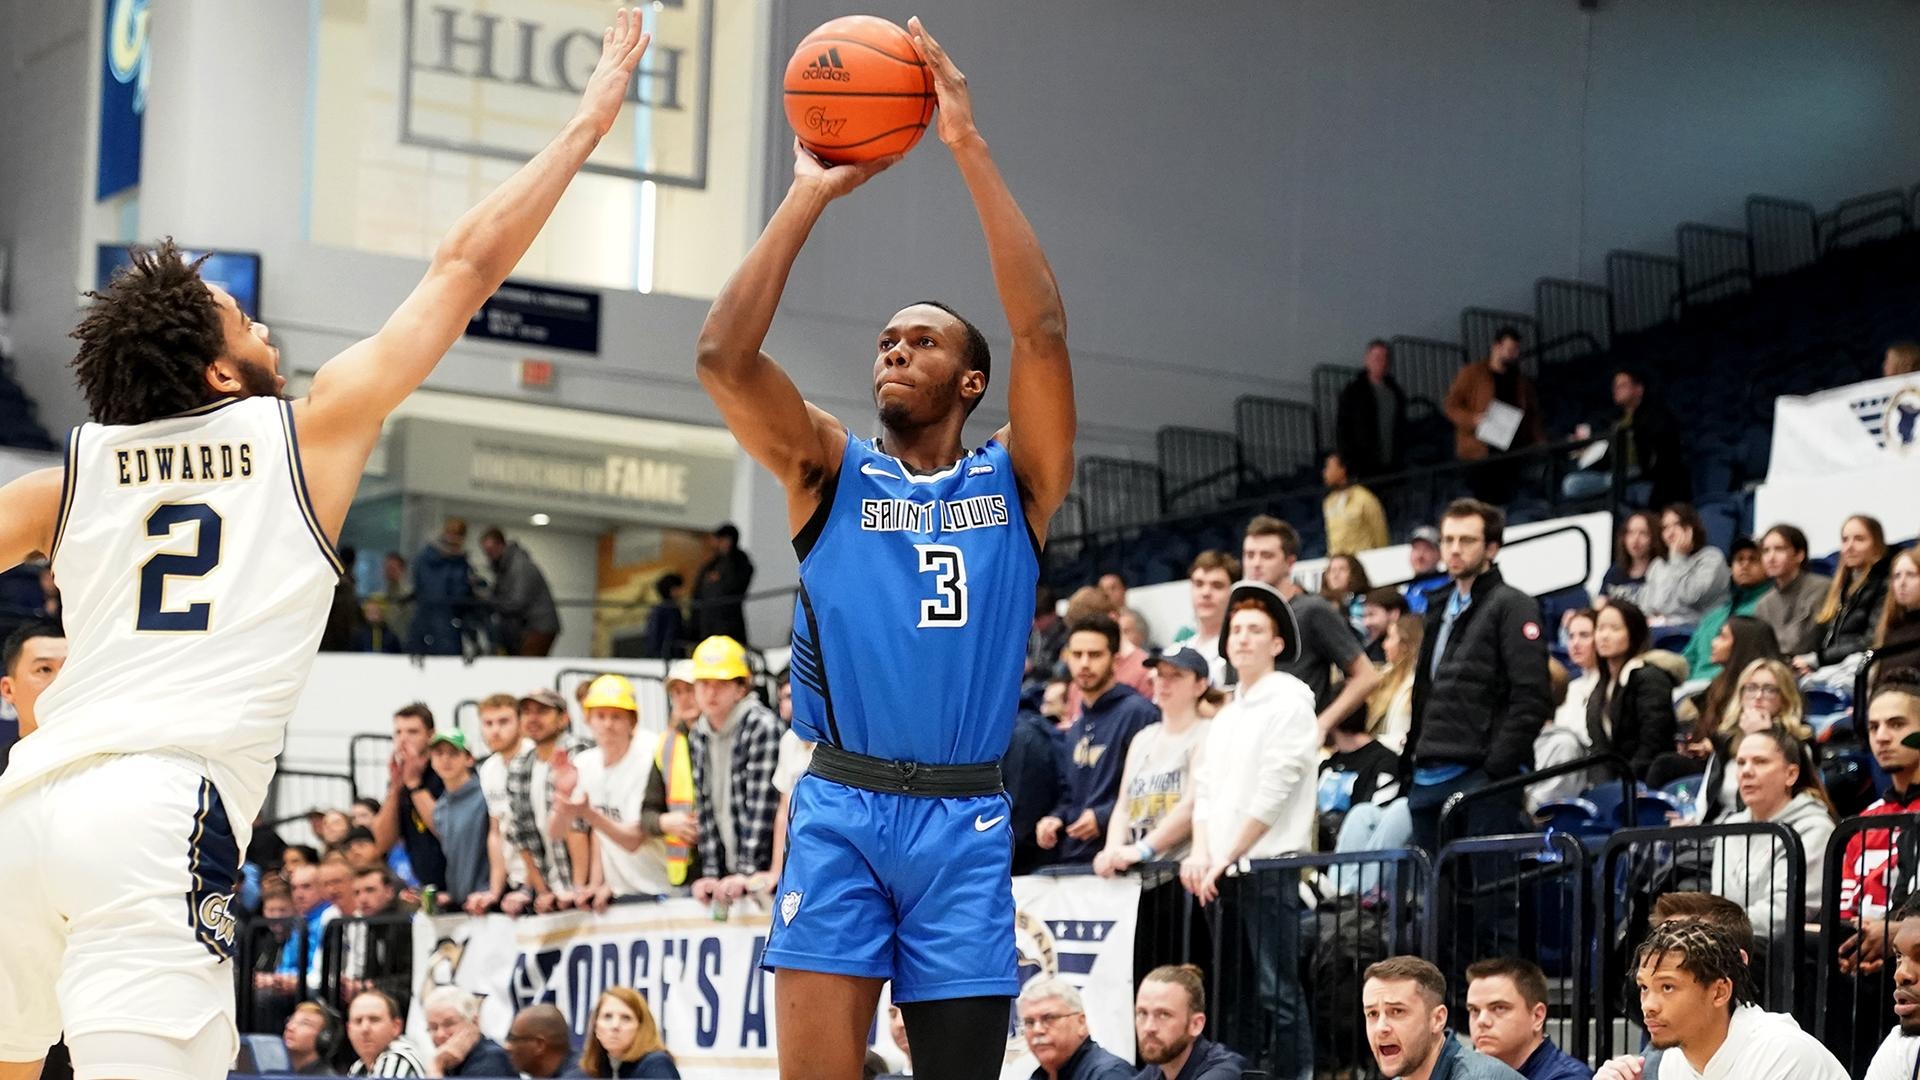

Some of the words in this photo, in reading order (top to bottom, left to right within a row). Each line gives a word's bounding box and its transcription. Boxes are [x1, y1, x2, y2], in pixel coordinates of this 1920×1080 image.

[433, 6, 683, 110] HIGH
[802, 67, 850, 82] adidas
[804, 106, 847, 137] GW
[116, 442, 253, 486] EDWARDS
[606, 455, 689, 504] FAME
[861, 499, 935, 534] SAINT
[940, 494, 1009, 532] LOUIS
[134, 501, 224, 633] 2
[913, 544, 968, 628] 3
